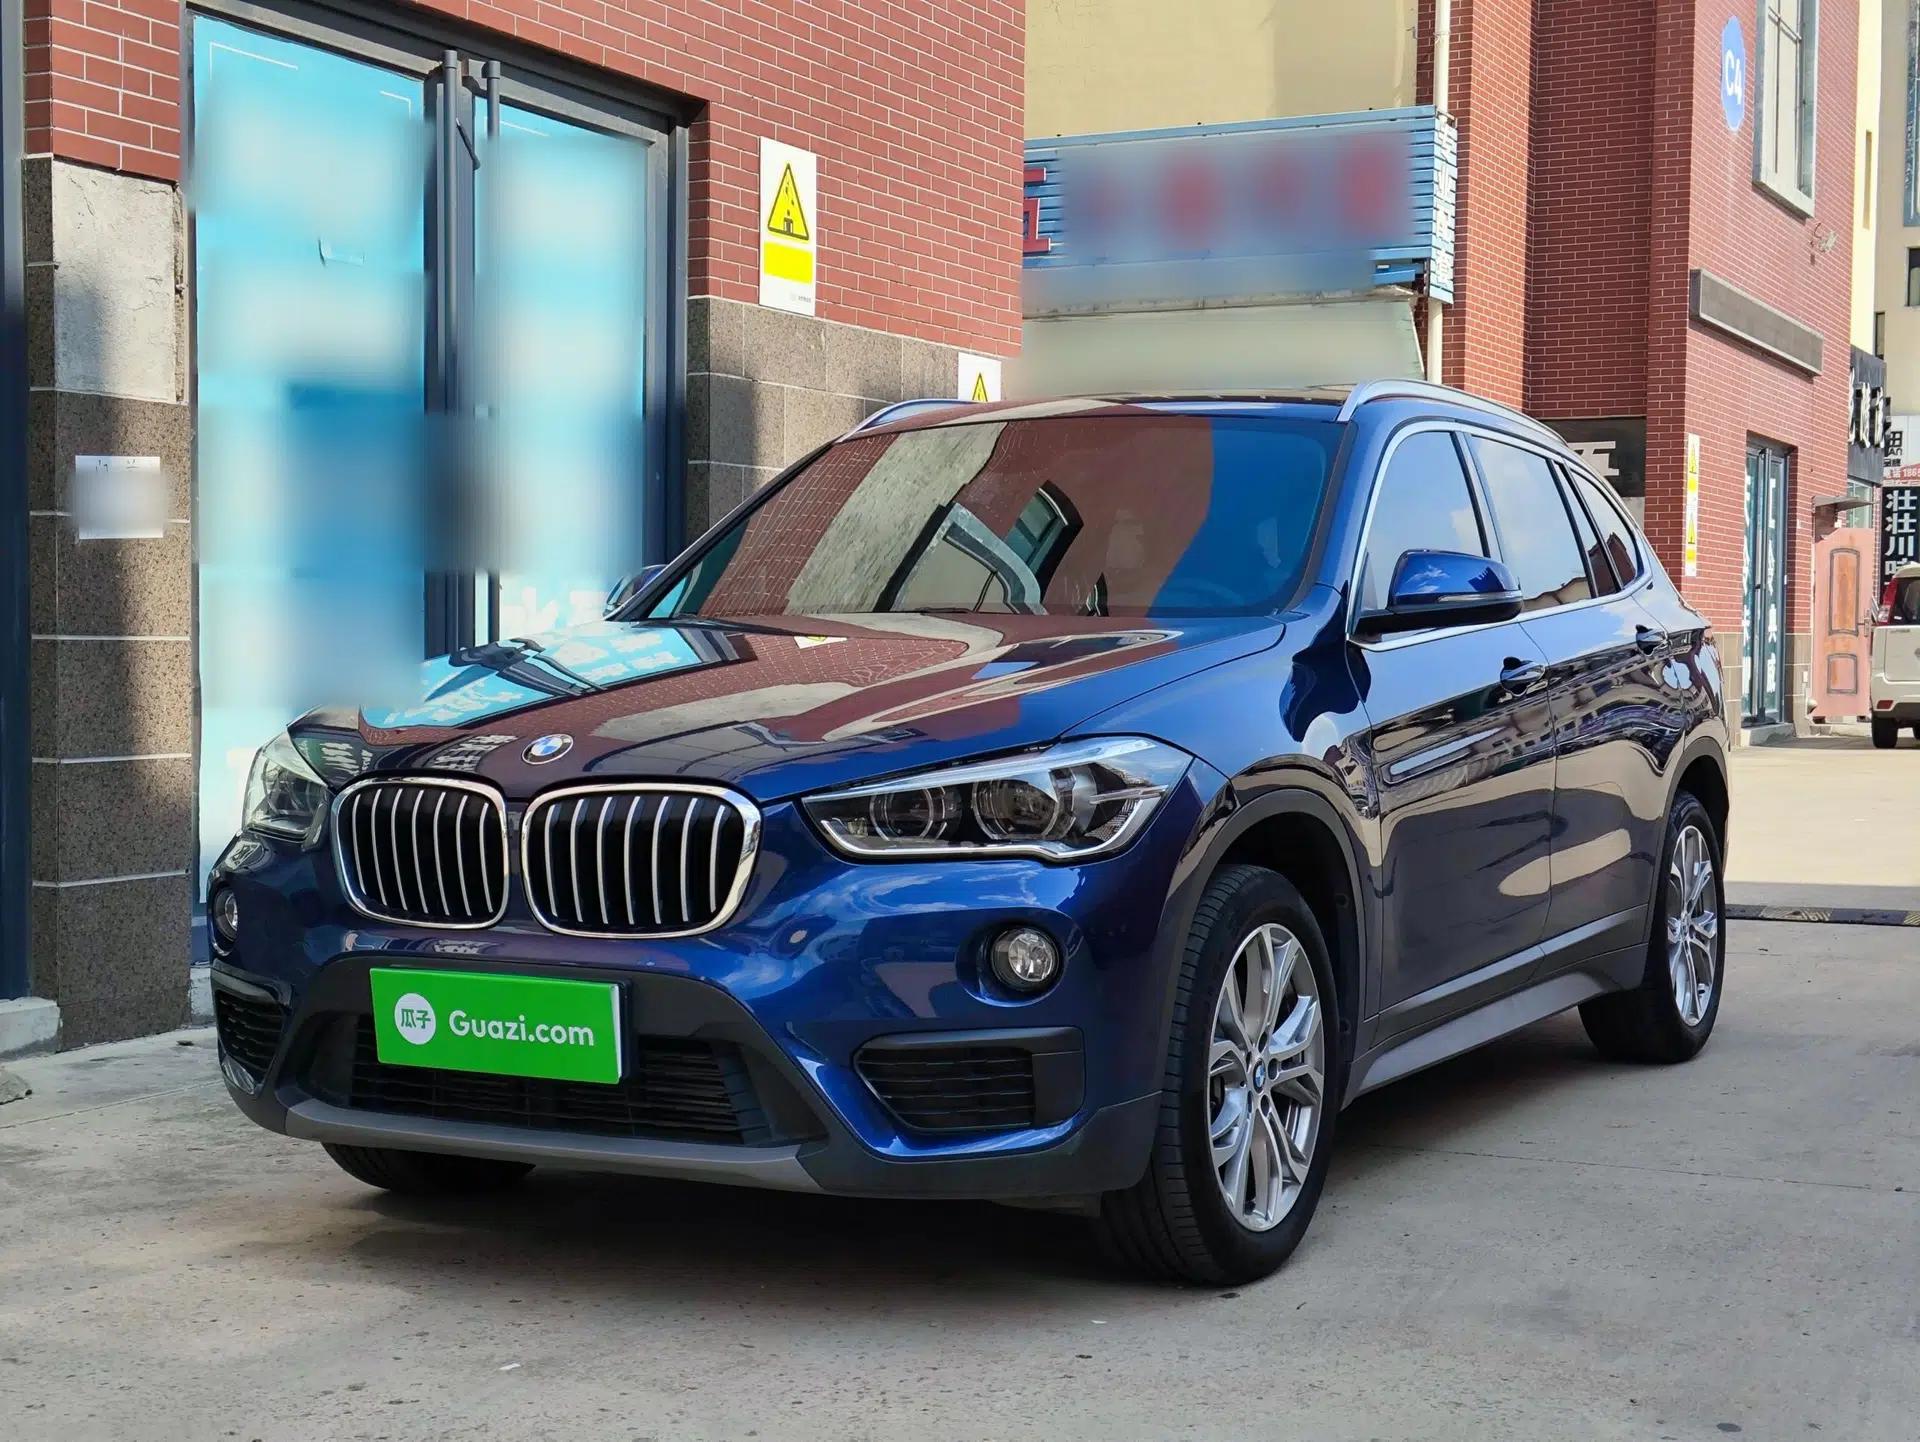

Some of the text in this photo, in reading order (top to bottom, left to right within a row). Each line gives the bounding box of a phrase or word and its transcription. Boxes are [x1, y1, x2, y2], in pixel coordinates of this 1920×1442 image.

[1725, 49, 1742, 105] C4
[400, 1008, 595, 1046] 瓜子 Guazi.com
